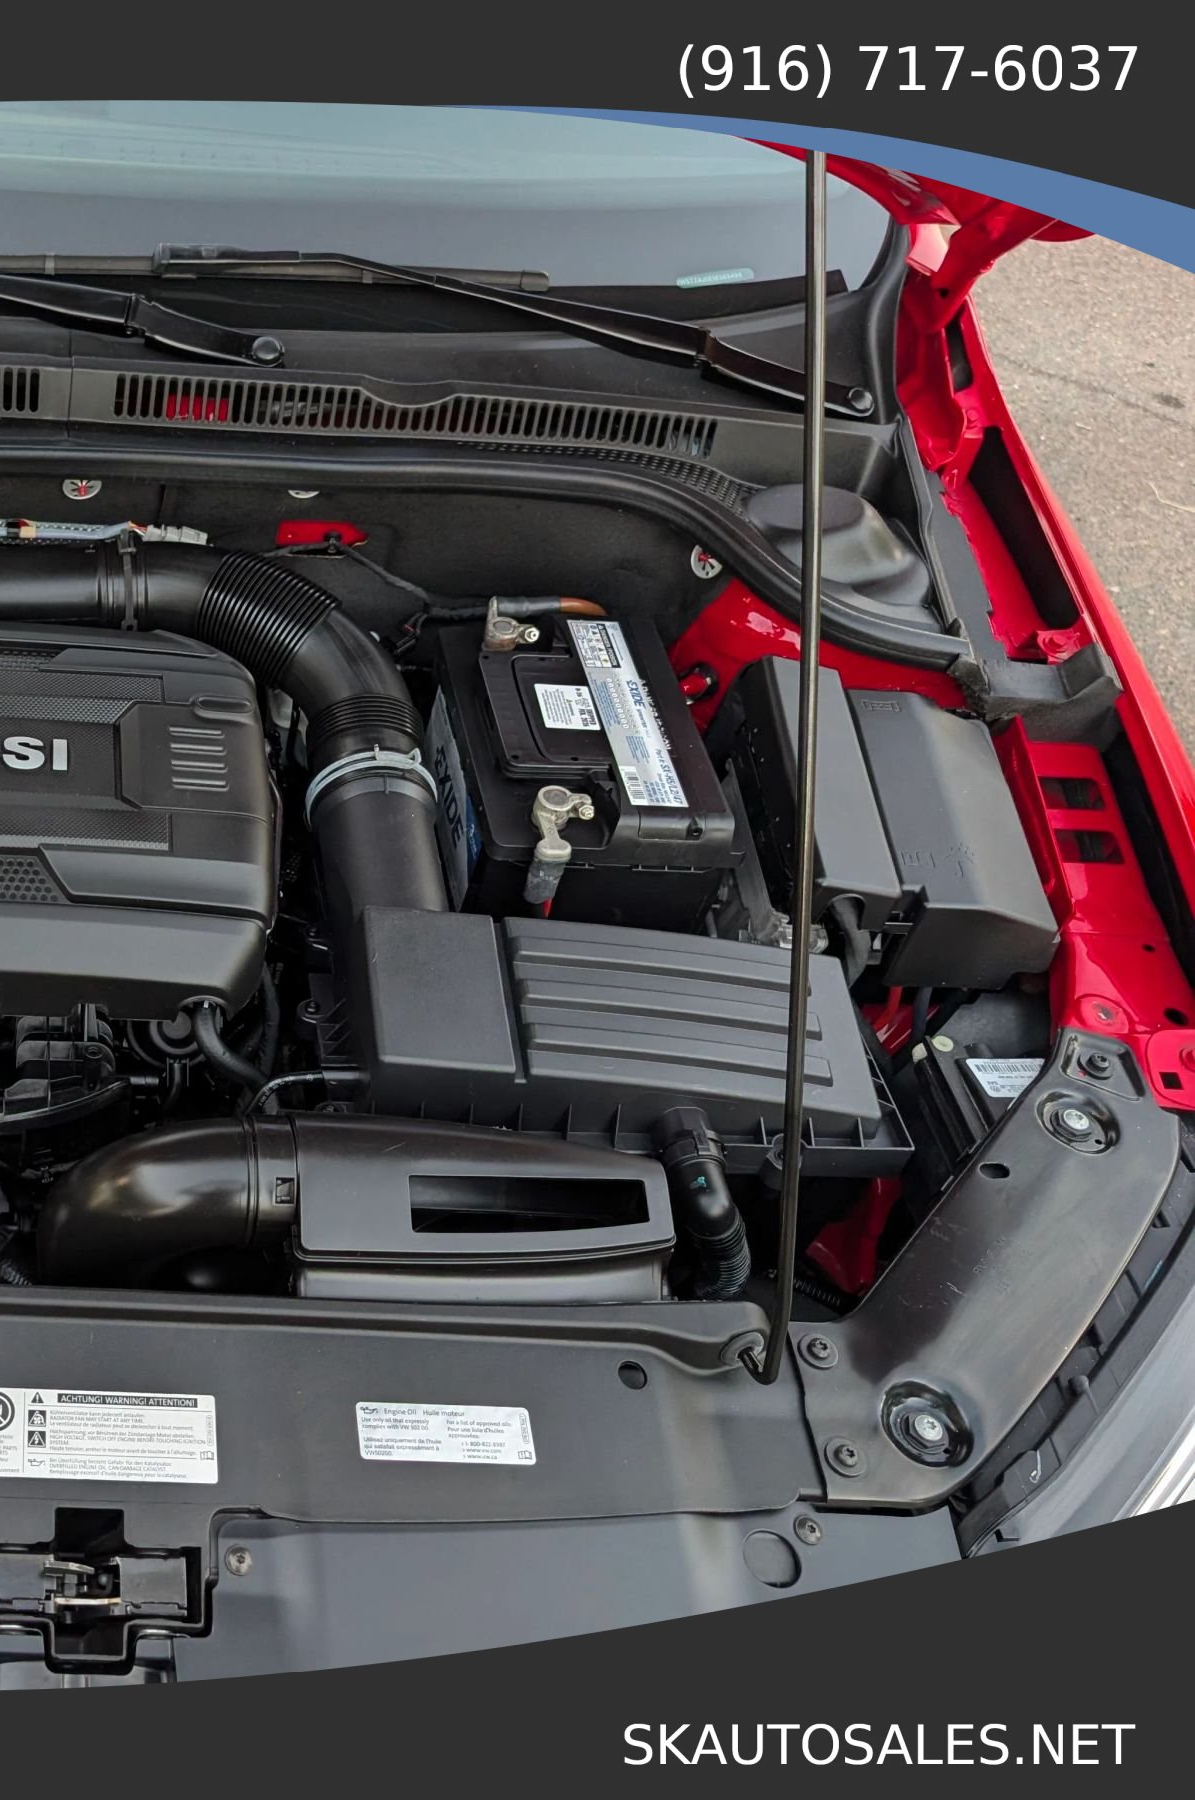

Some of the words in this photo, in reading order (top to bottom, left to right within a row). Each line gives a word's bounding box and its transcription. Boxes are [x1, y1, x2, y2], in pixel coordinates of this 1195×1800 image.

[625, 680, 646, 709] EXIDE
[434, 744, 464, 849] EXIDE
[60, 1394, 104, 1404] ACHTUNG!
[105, 1396, 147, 1406] WARNING!
[148, 1398, 195, 1407] ATTENTION!
[384, 1408, 406, 1416] Engine
